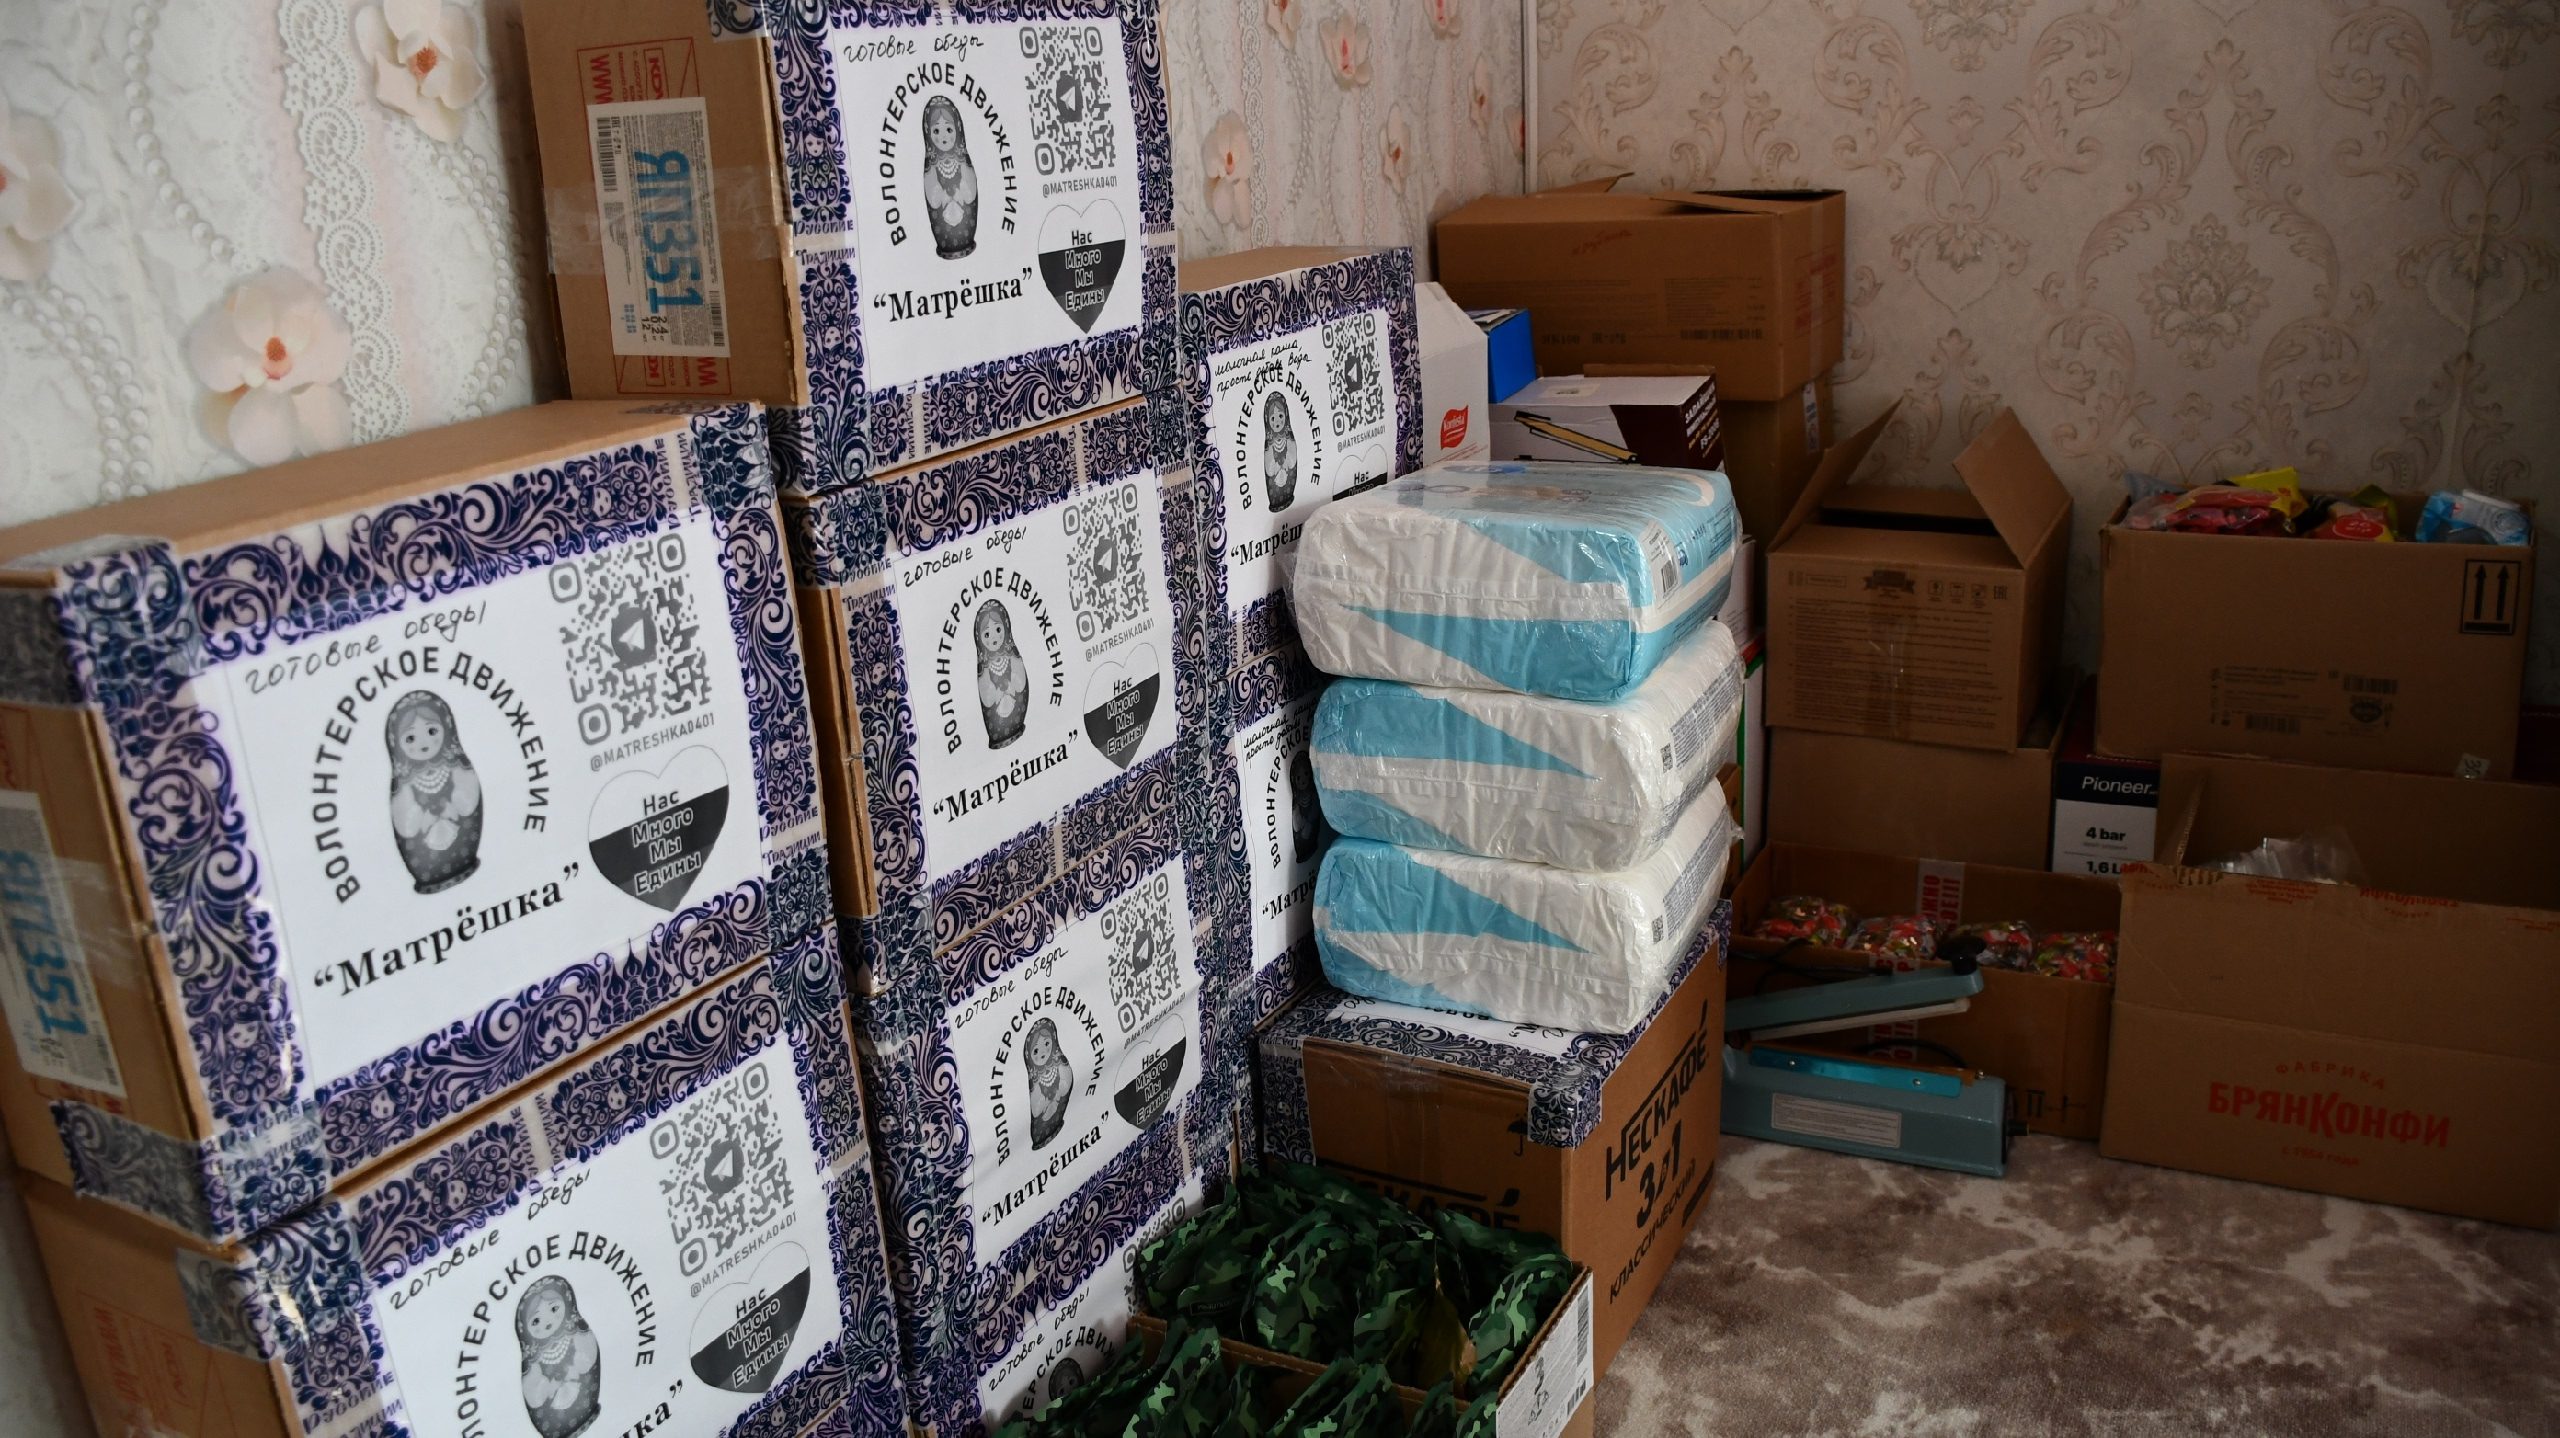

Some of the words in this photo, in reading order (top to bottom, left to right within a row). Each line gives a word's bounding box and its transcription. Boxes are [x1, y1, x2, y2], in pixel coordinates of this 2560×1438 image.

[879, 62, 955, 246] ВОЛОНТЕРСКОЕ
[959, 74, 1018, 236] ДВИЖЕНИЕ
[634, 150, 704, 314] ЯП351
[1071, 230, 1093, 246] Нас
[1065, 249, 1102, 269] Много
[1075, 269, 1094, 287] Мы
[873, 267, 1033, 322] “Матрёшка”
[1065, 288, 1105, 312] Едины
[1235, 366, 1284, 511] ВОЛОНТЕРСКОЕ
[1285, 371, 1322, 486] ДВИЖЕНИЕ
[903, 550, 974, 587] готовые
[986, 527, 1027, 555] обеды
[1230, 521, 1303, 565] “Матрёш
[246, 634, 382, 694] готовые
[404, 600, 486, 643] обеды
[936, 566, 1004, 755] ВОЛОНТЕРСКОЕ
[1008, 571, 1065, 707] ДВИЖЕНИЕ
[1107, 689, 1140, 721] Много
[1112, 677, 1132, 700] Нас
[589, 714, 716, 773] @MATRESHKA0401
[1107, 724, 1145, 756] Едины
[1114, 712, 1135, 732] Мы
[310, 645, 438, 903] ВОЛОНТЕРСКОЕ
[447, 652, 551, 833] ДВИЖЕНИЕ
[933, 729, 1079, 823] “Матрёшка”
[2081, 775, 2153, 796] Pioneer
[642, 788, 680, 815] Нас
[1266, 725, 1310, 869] ВОЛОНТЕРСКОЕ
[632, 807, 694, 845] Много
[648, 833, 683, 864] Мы
[2086, 827, 2097, 840] 4
[2100, 828, 2126, 842] bar
[632, 851, 702, 895] Едины
[2086, 861, 2109, 875] 1,6
[1262, 871, 1319, 918] “Матрё
[313, 862, 580, 998] “Матрёшка”
[954, 981, 1016, 1029] готовые
[989, 986, 1054, 1166] ВОЛОНТЕРСКОЕ
[1054, 985, 1105, 1097] ДВИЖЕНИЕ
[1135, 1060, 1169, 1092] Много
[1141, 1047, 1161, 1070] Нас
[2275, 1060, 2387, 1090] ФАБРИКА
[1136, 1089, 1172, 1125] Едины
[1144, 1079, 1163, 1102] Мы
[981, 1110, 1110, 1228] “Матрёшка”
[1636, 1161, 1655, 1229] 3
[1671, 1119, 1682, 1182] 1
[389, 1228, 500, 1311] готовые
[528, 1169, 592, 1221] обеды
[1609, 1156, 1697, 1304] КЛАССИЧЕСКИЙ
[726, 1298, 782, 1349] Много
[735, 1287, 768, 1321] Нас
[456, 1241, 562, 1438] ЛОНТЕРСКОЕ
[568, 1231, 655, 1368] ДВИЖЕНИЕ
[743, 1327, 772, 1358] Мы
[732, 1334, 790, 1391] Едины
[1022, 1329, 1074, 1410] ЕРСКОЕ
